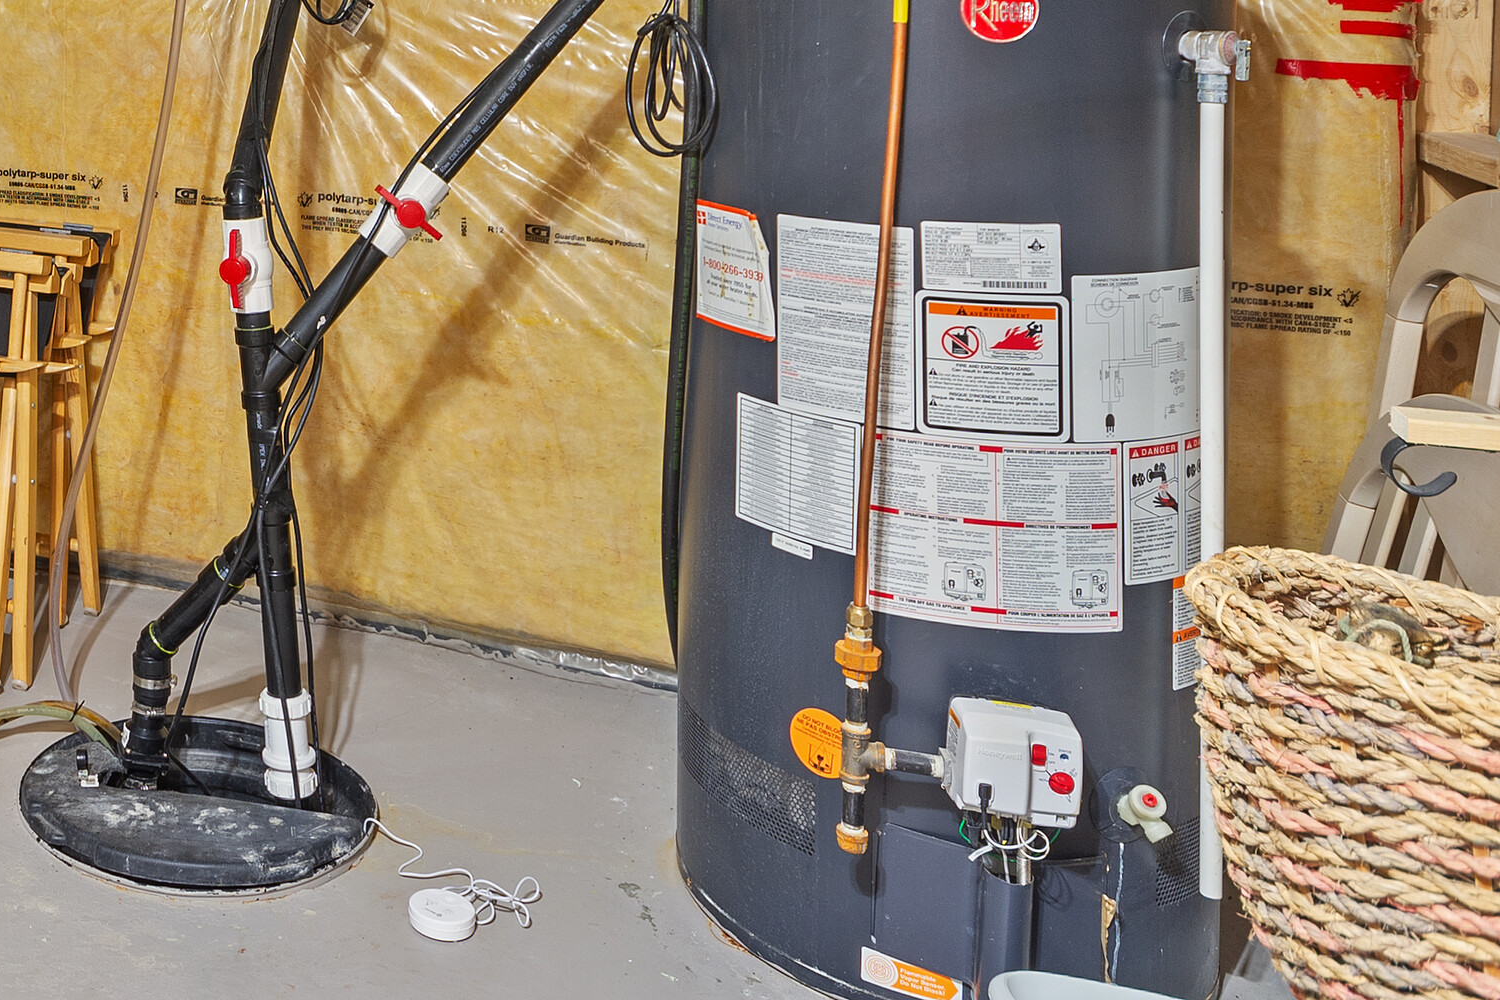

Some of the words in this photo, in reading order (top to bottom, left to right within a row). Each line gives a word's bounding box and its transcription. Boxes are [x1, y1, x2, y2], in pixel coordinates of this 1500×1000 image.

[71, 172, 86, 182] six
[707, 212, 722, 222] Direct
[722, 217, 743, 230] Energy
[487, 225, 505, 234] R12
[554, 232, 585, 242] Guardian
[586, 235, 614, 246] Building
[614, 239, 646, 249] Products
[1231, 280, 1304, 296] rp-super
[1308, 285, 1333, 297] six
[970, 311, 1030, 319] AVERTISSEMENT
[1294, 313, 1342, 323] DEVELOPMENT
[1270, 324, 1296, 332] SPREAD
[1298, 326, 1322, 334] RATING
[1141, 443, 1176, 456] DANGER
[812, 718, 824, 727] NOT
[978, 748, 1023, 761] Honeywell
[900, 967, 936, 983] Flammable
[900, 973, 919, 984] Vapor
[900, 979, 909, 987] Do
[910, 983, 923, 991] Not
[923, 986, 945, 996] Block!
